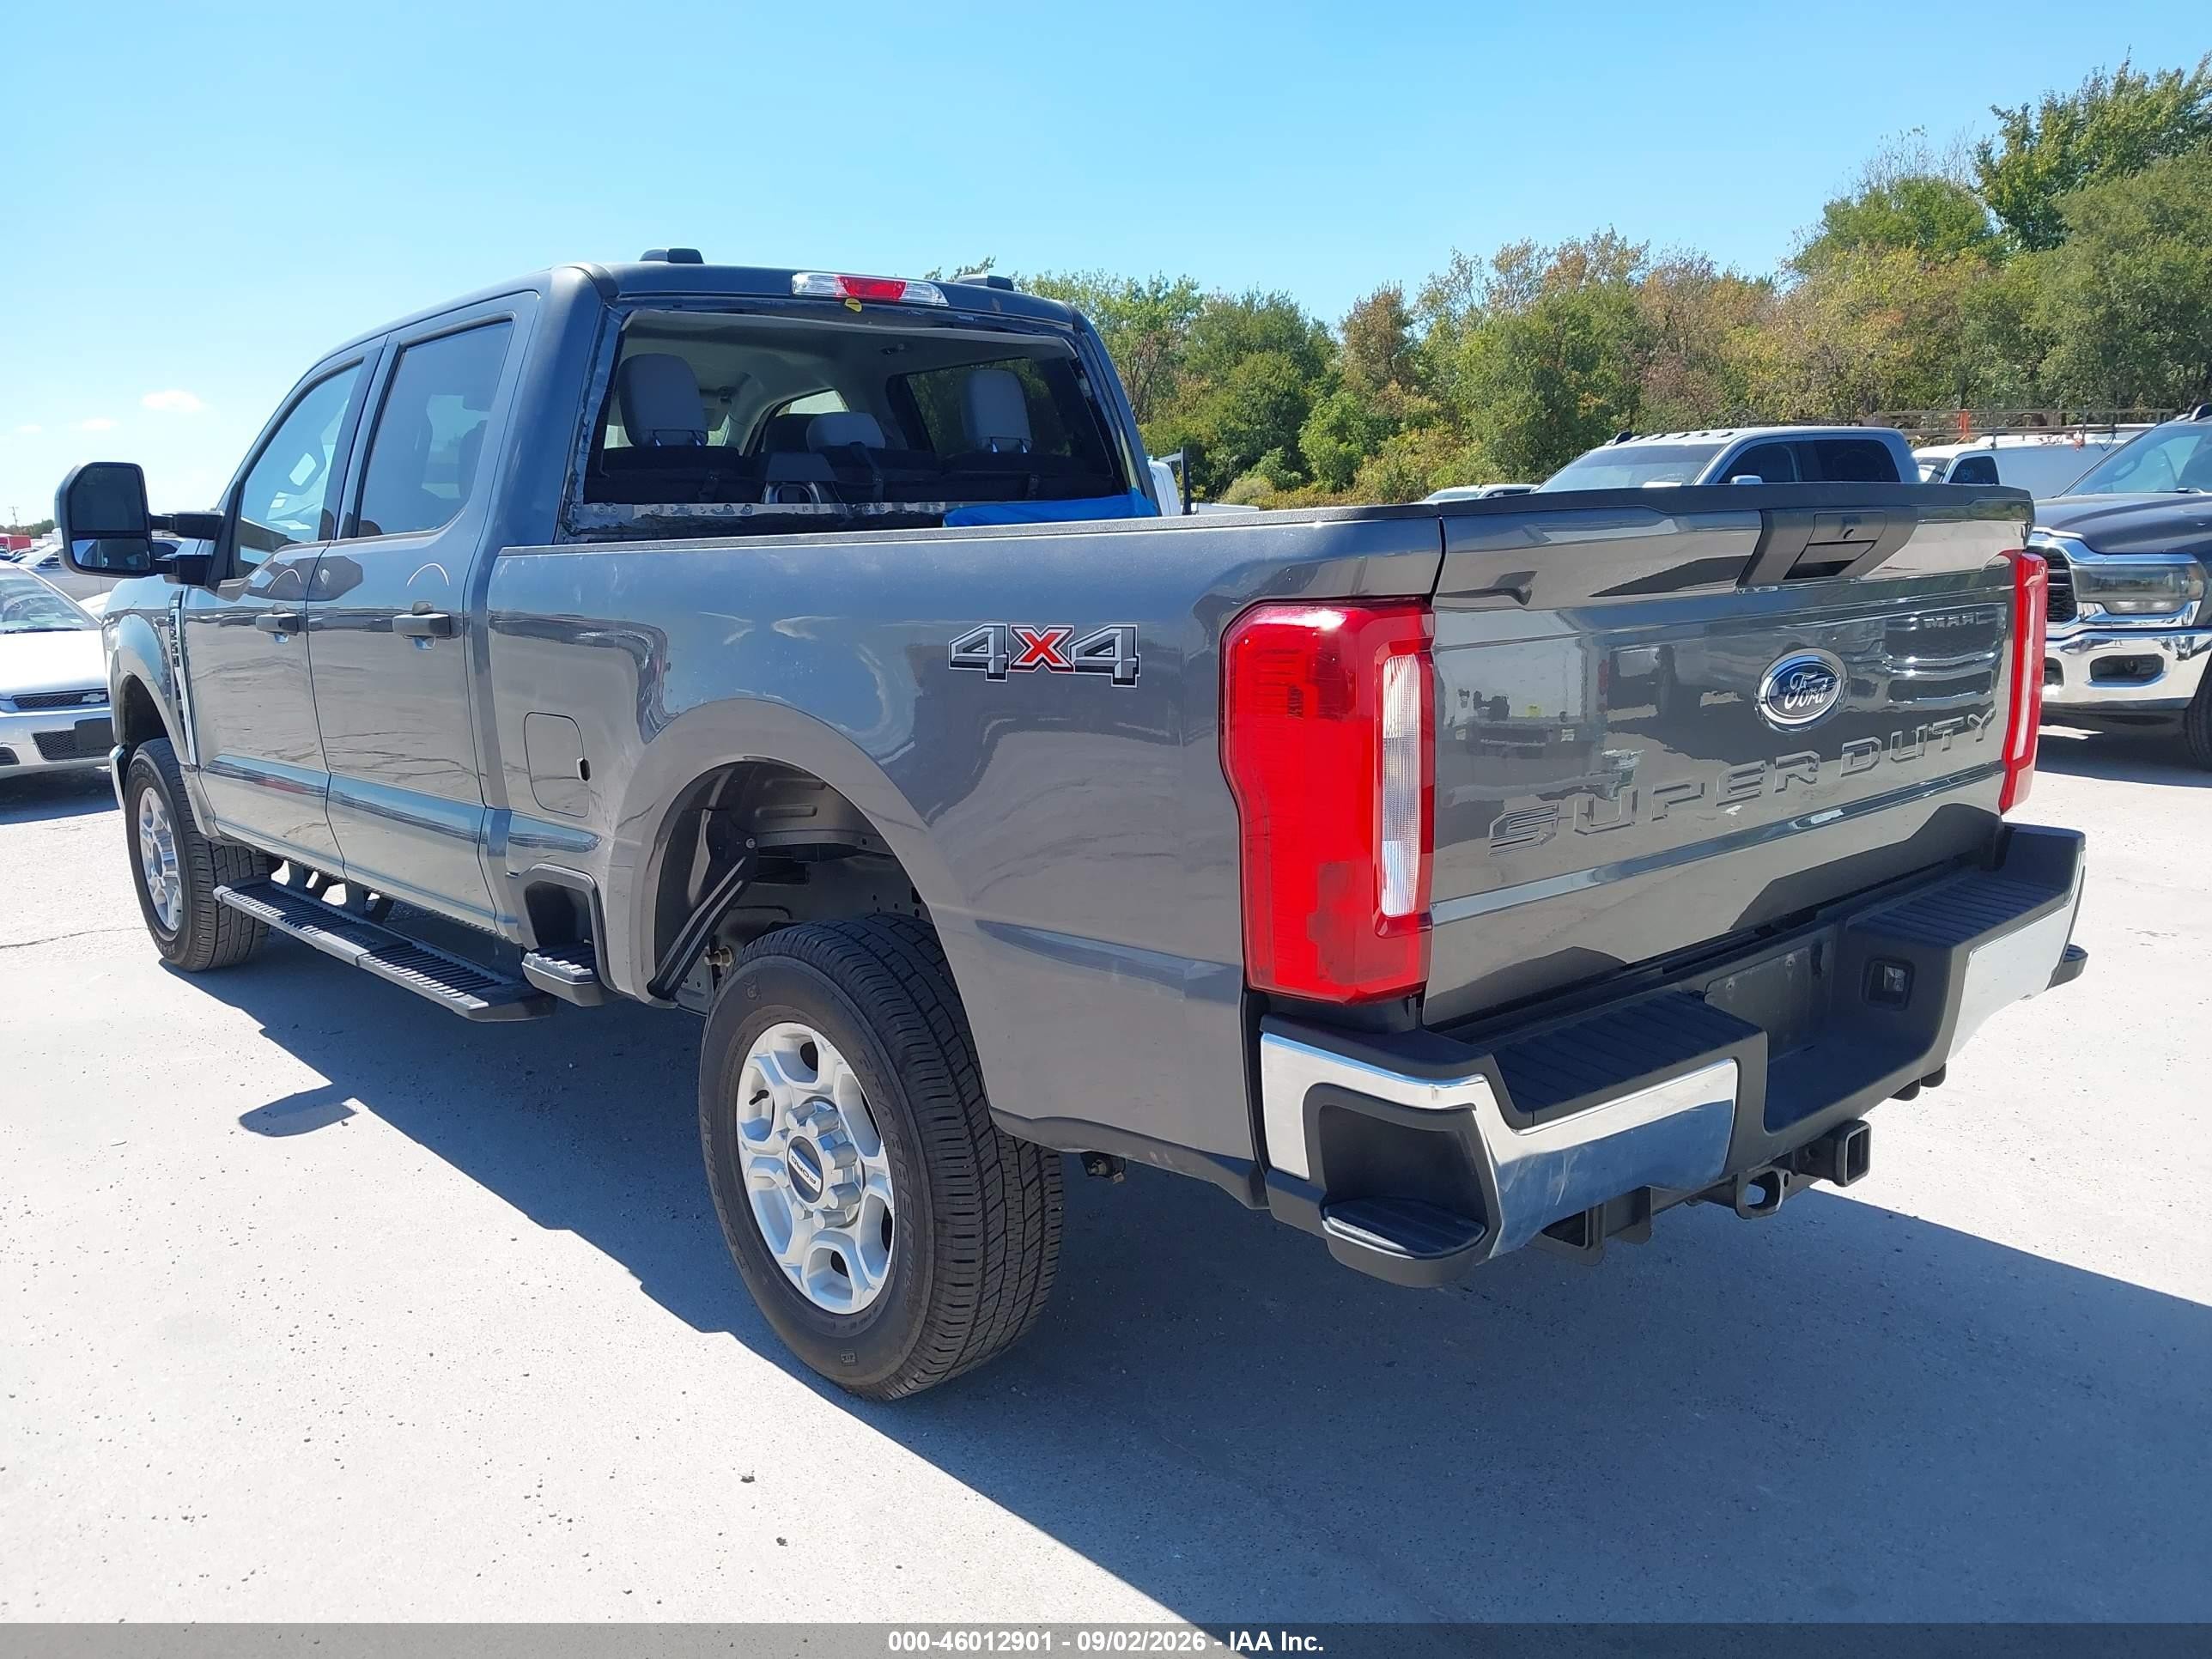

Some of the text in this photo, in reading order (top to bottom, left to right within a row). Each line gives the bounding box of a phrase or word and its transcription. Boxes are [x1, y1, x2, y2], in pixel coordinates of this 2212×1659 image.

[1784, 672, 1836, 710] Ford
[1487, 708, 1996, 858] SUPER DUTY
[790, 1155, 817, 1185] FORD
